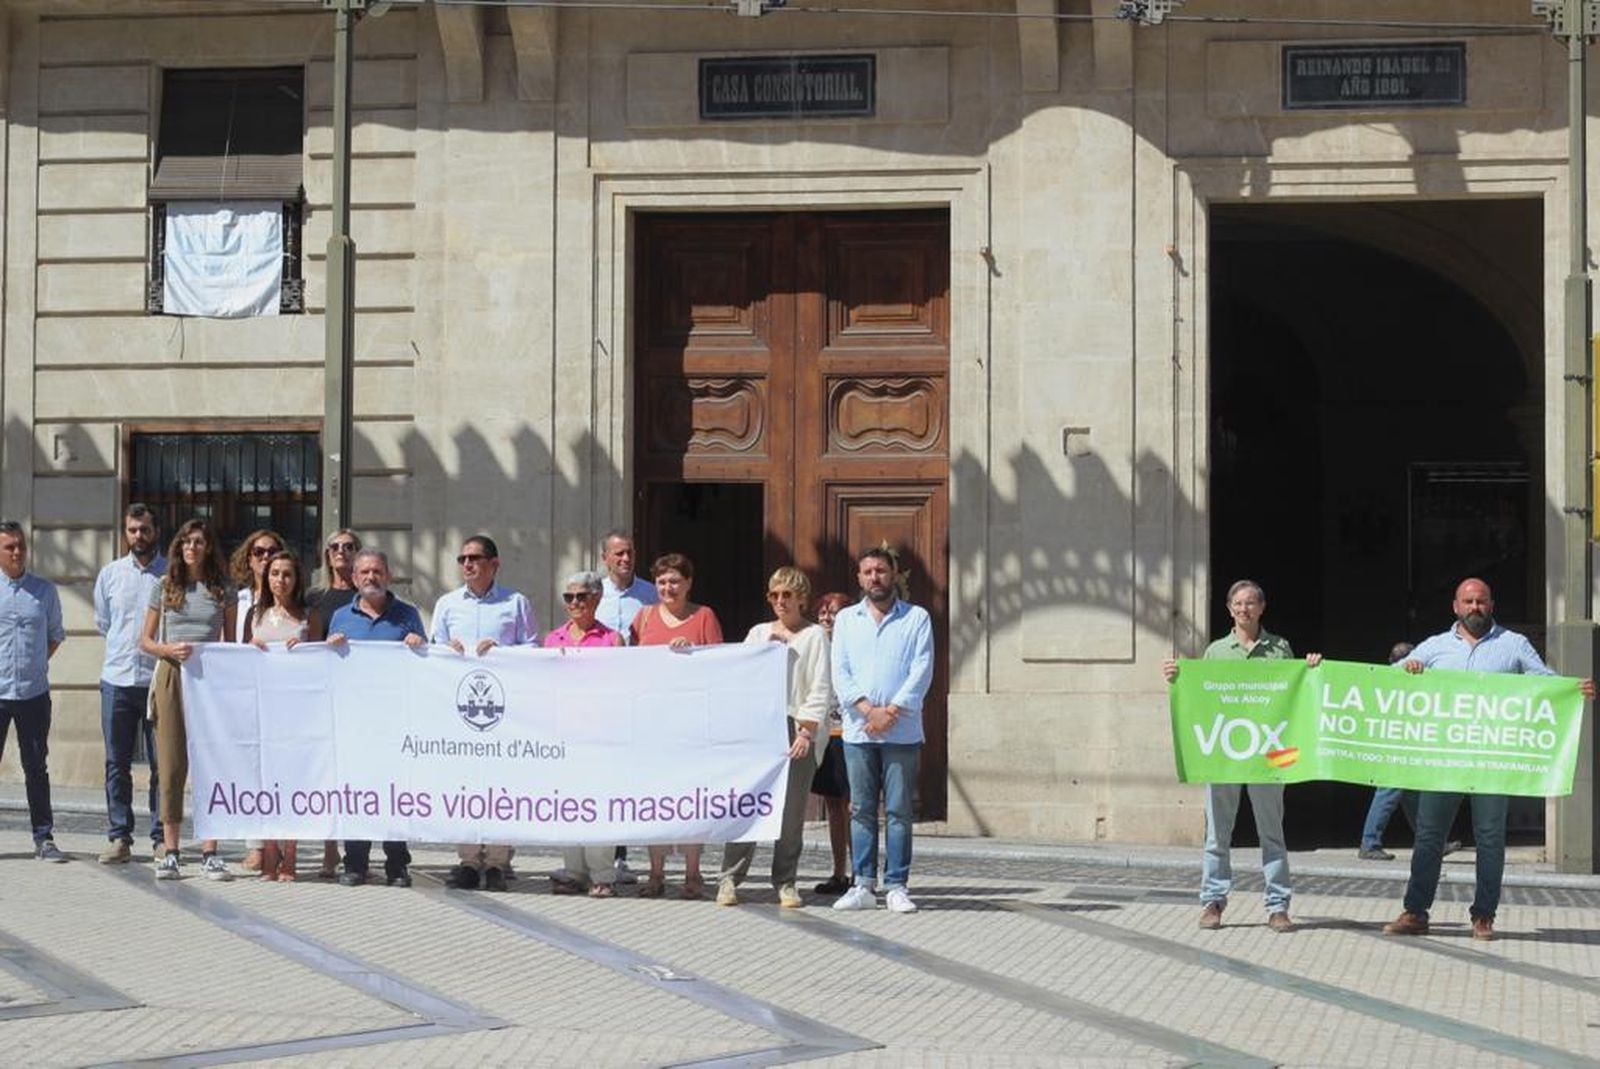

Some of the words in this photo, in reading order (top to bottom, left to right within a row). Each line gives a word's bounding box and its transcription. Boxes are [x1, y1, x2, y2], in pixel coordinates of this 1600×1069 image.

[712, 74, 749, 104] CASA
[1203, 680, 1236, 691] Grupo
[1237, 680, 1289, 690] municipal
[1321, 683, 1364, 711] LA
[1374, 687, 1557, 725] VIOLENCIA
[401, 734, 502, 758] Ajuntament
[507, 739, 566, 759] d'Alcoi
[1318, 712, 1357, 735] NO
[1364, 718, 1439, 742] TIENE
[1446, 719, 1557, 750] GÉNERO
[208, 782, 281, 816] Alcoi
[291, 782, 380, 816] contra
[390, 784, 432, 816] les
[442, 785, 597, 822] violències
[608, 786, 773, 822] masclistes
